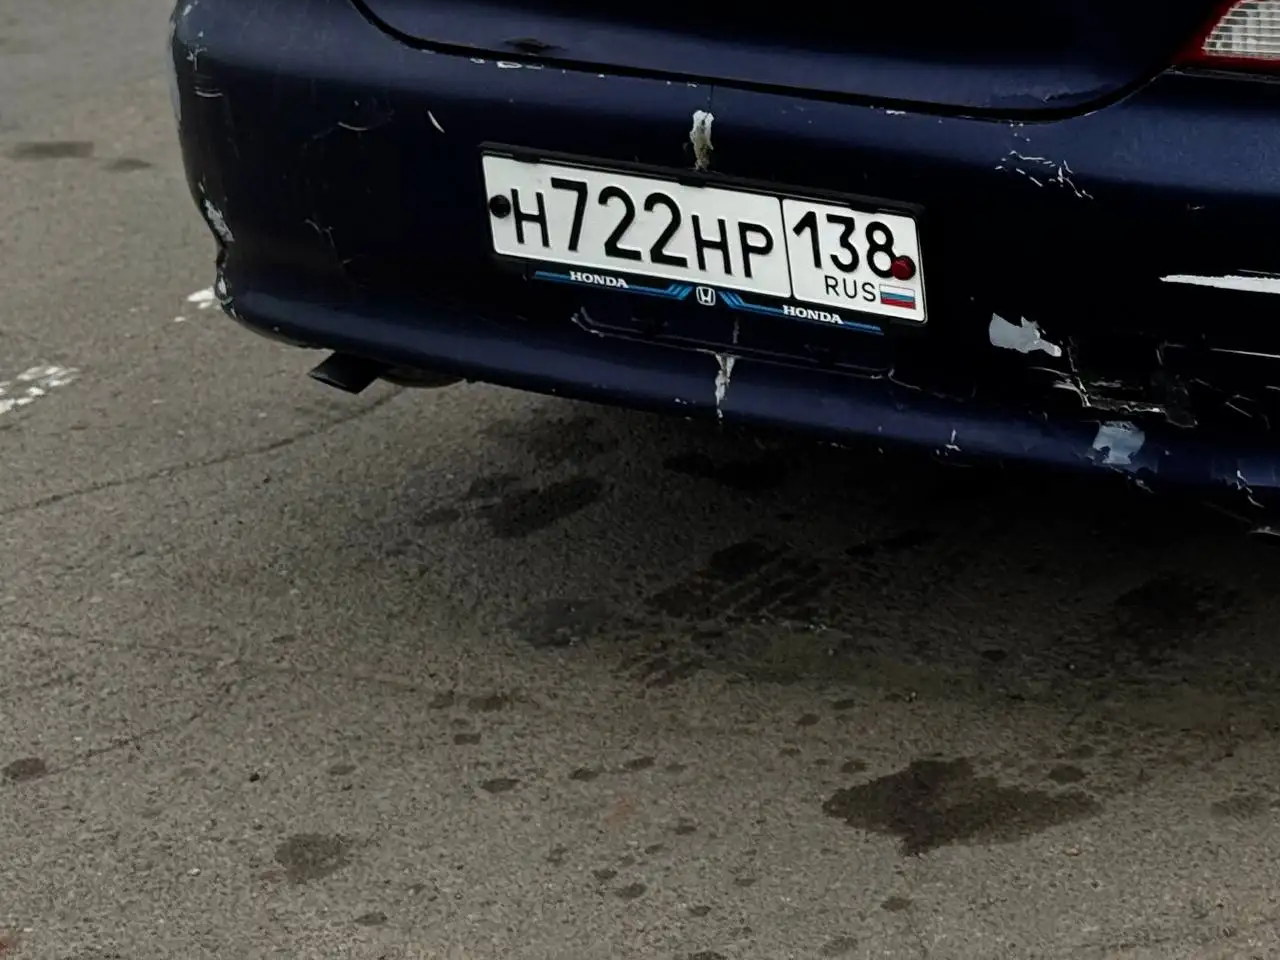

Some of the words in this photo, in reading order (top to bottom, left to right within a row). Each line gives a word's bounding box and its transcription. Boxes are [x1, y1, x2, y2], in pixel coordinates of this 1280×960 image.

[792, 210, 901, 278] 138
[569, 270, 629, 289] HONDA
[824, 276, 877, 302] RUS
[782, 306, 843, 324] HONDA
